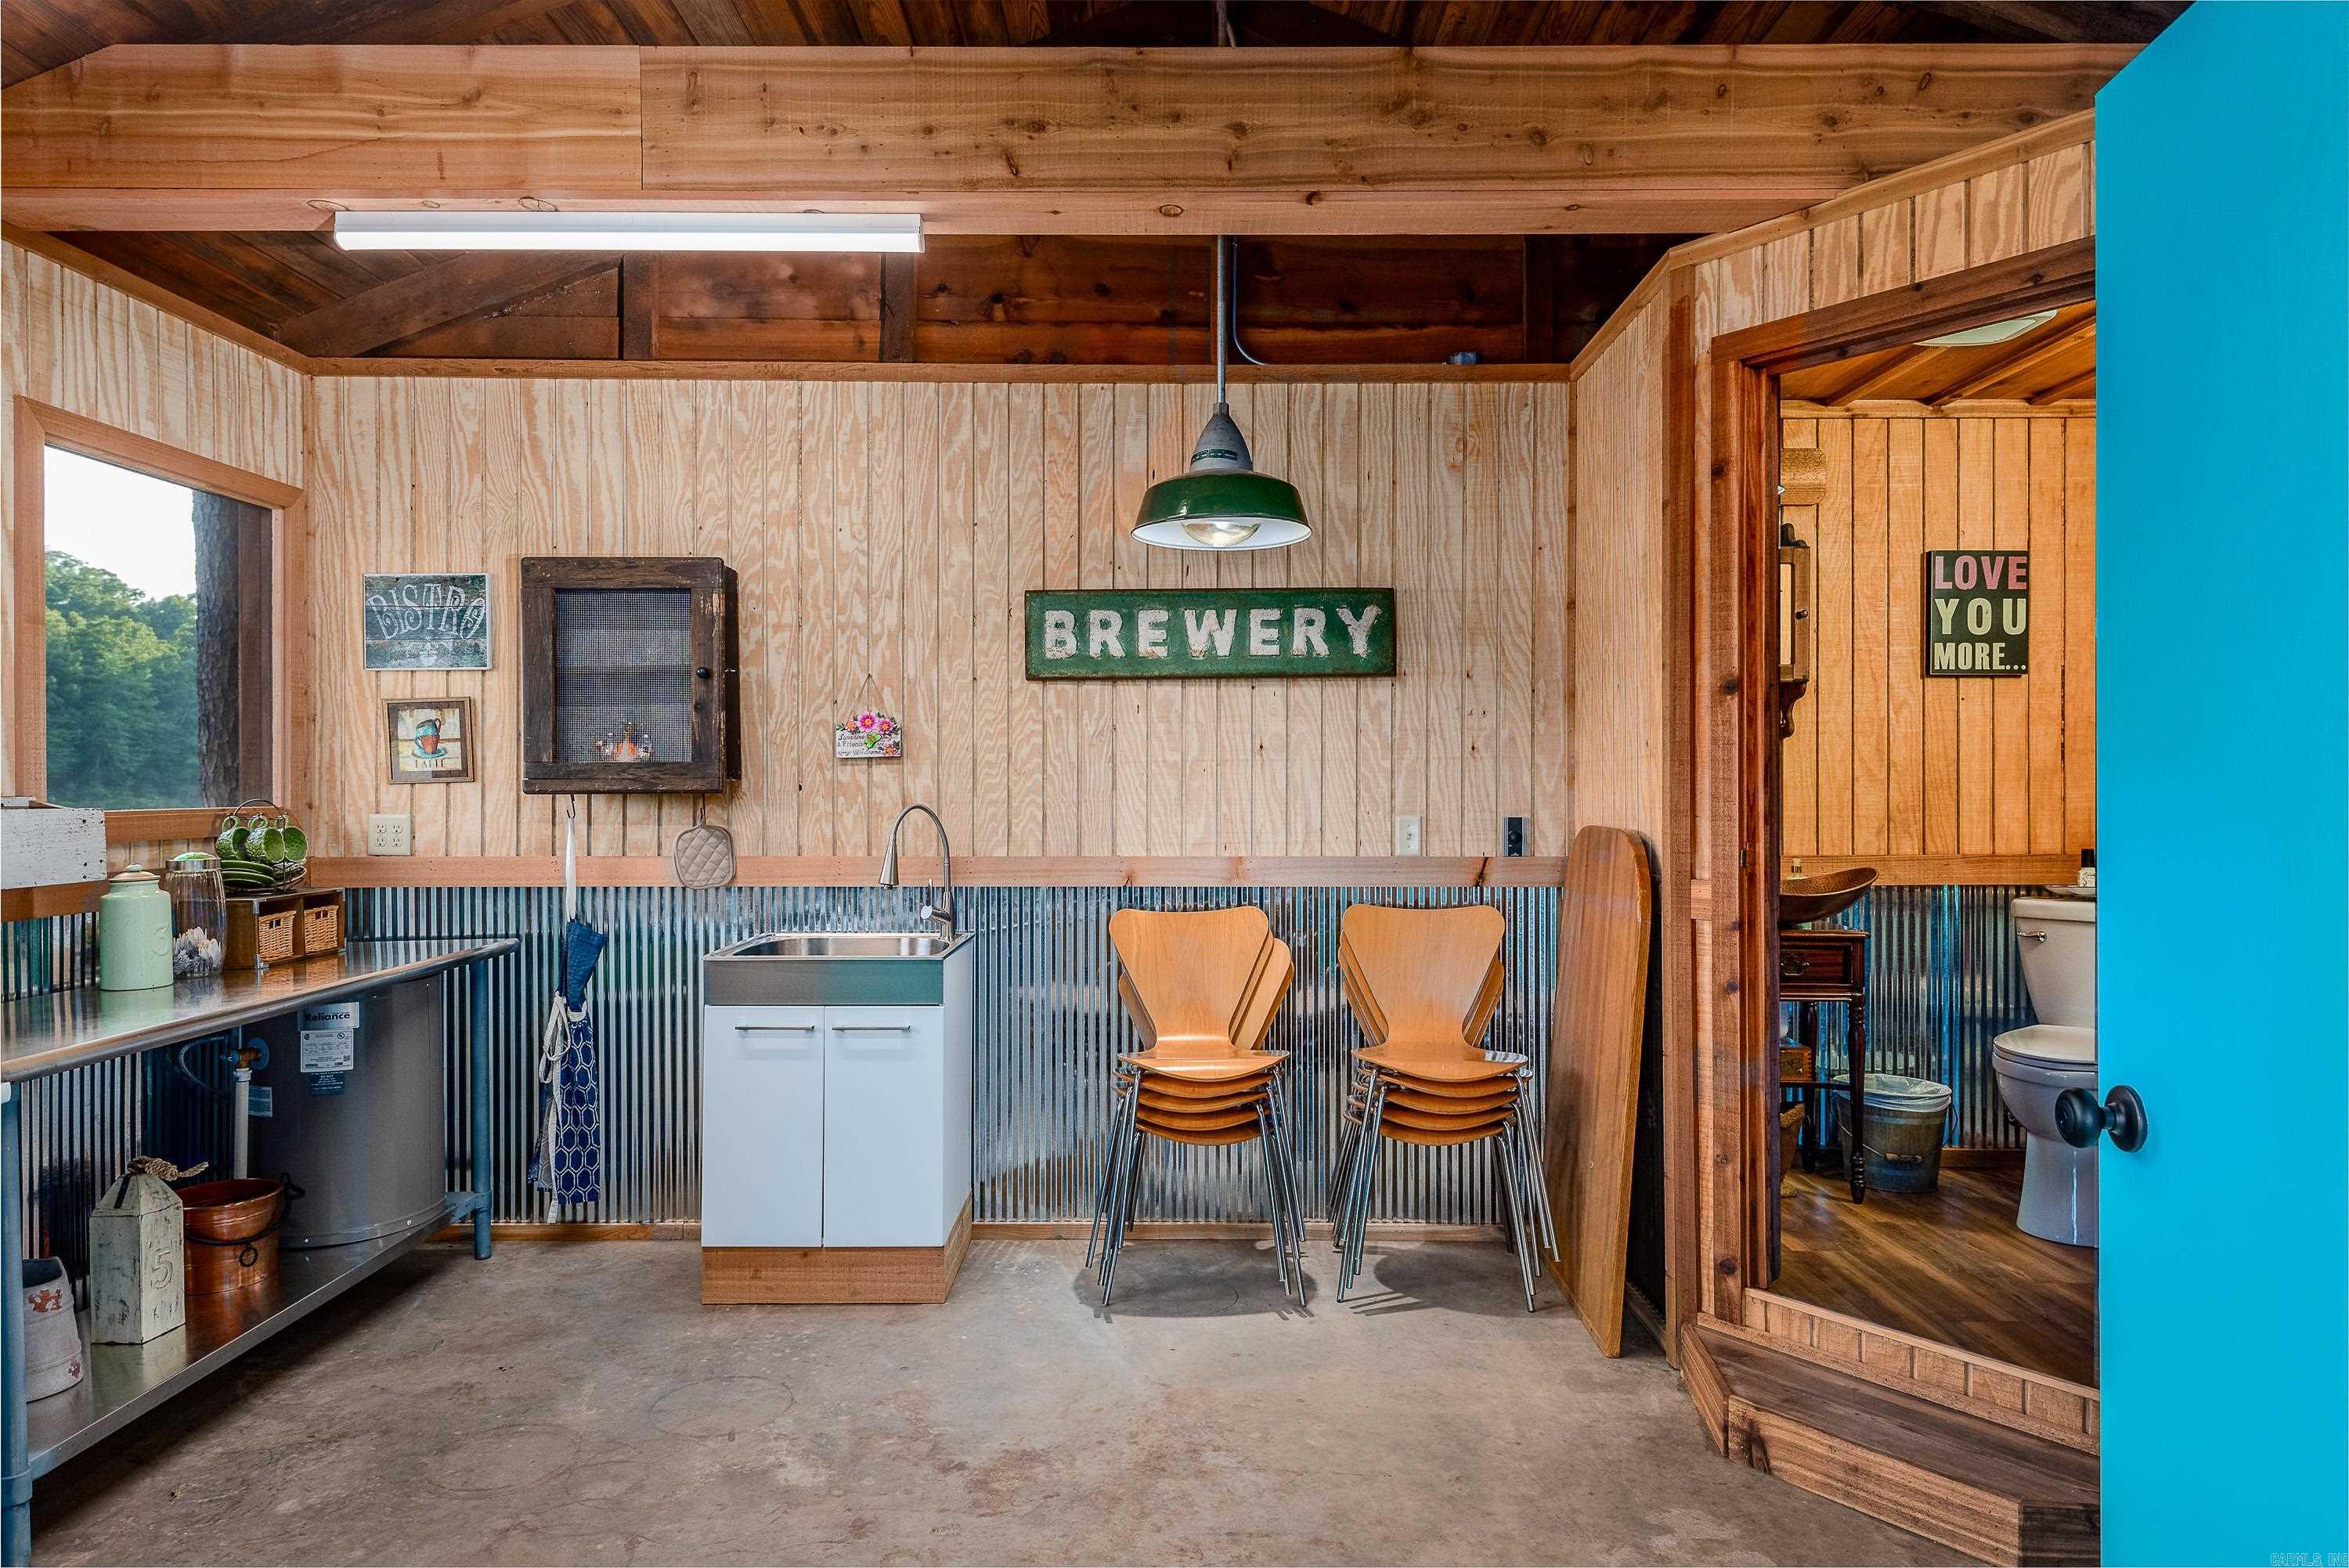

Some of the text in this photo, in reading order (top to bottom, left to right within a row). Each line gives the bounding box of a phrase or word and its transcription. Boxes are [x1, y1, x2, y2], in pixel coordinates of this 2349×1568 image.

[1935, 555, 2028, 590] LOVE
[366, 583, 485, 639] BISTRO
[1934, 598, 2026, 636] YOU
[1044, 604, 1383, 659] BREWERY
[1934, 642, 2026, 670] MORE...
[305, 1012, 351, 1022] Reliance
[152, 1248, 173, 1289] 5
